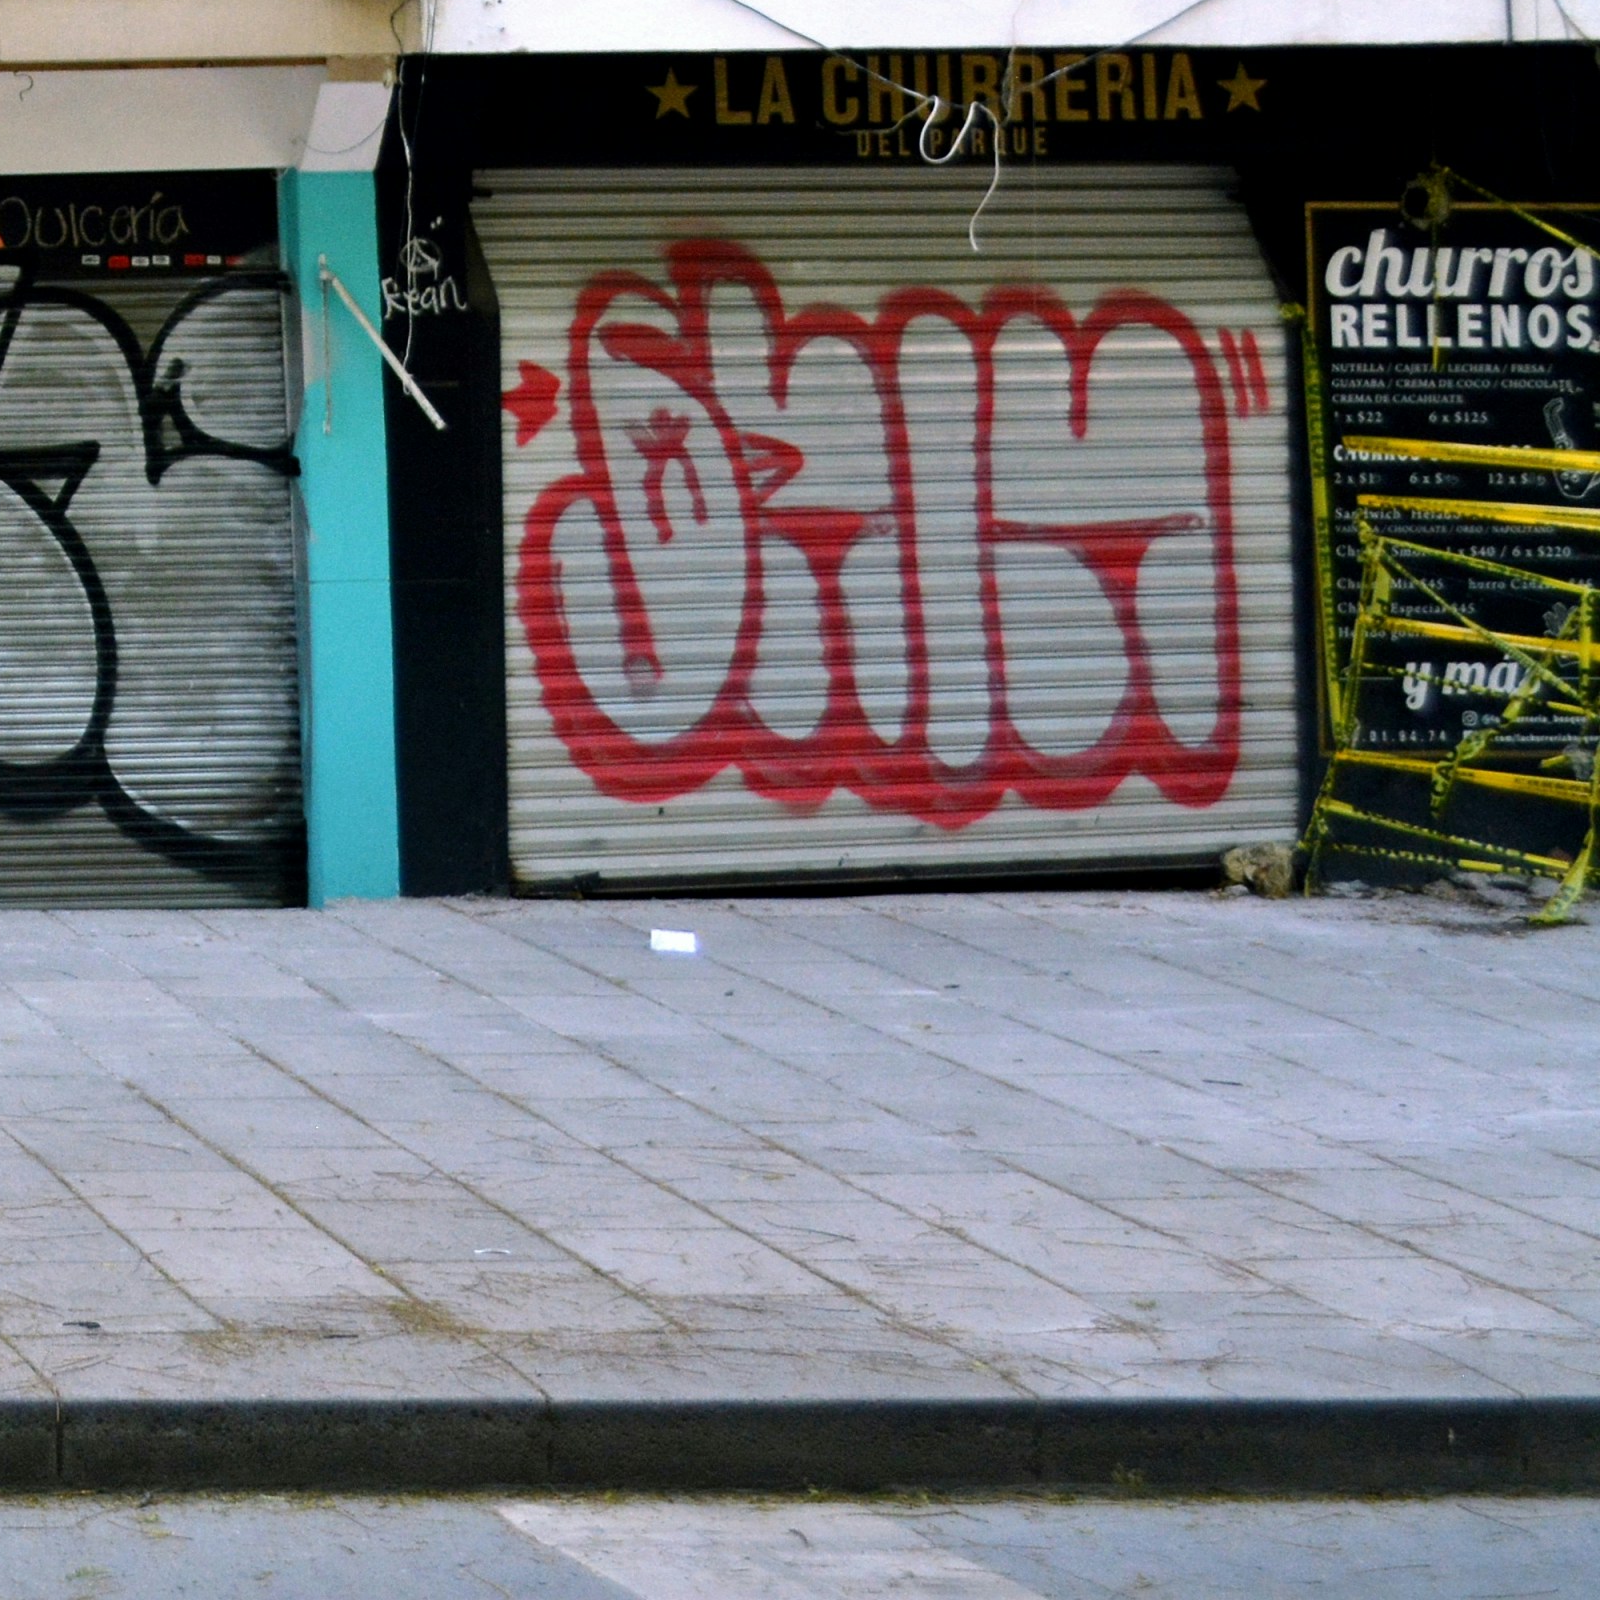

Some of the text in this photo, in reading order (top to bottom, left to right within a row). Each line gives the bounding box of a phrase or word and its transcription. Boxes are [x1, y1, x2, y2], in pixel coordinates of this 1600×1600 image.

[714, 51, 1203, 125] LA CHURRERIA
[856, 127, 1048, 157] DEL PARQUE
[1324, 228, 1593, 297] churros
[1331, 303, 1593, 348] RELLENOS
[1331, 363, 1384, 373] NUTELLA
[1448, 363, 1500, 373] LECHERA
[1511, 363, 1545, 373] FRESA
[1331, 379, 1573, 390] GUAYABA CREMA DE COCO CHOCOLATE
[1332, 394, 1464, 403] CREMA DE CACAHUATE
[1357, 411, 1383, 424] $22
[1429, 412, 1437, 423] 6
[1454, 411, 1488, 424] $125
[1334, 473, 1342, 484] 2
[1409, 473, 1417, 484] 6
[1470, 545, 1496, 557] $40
[1512, 546, 1521, 557] 6
[1537, 545, 1572, 557] $220
[1468, 578, 1505, 590] hurro
[1403, 662, 1431, 709] y
